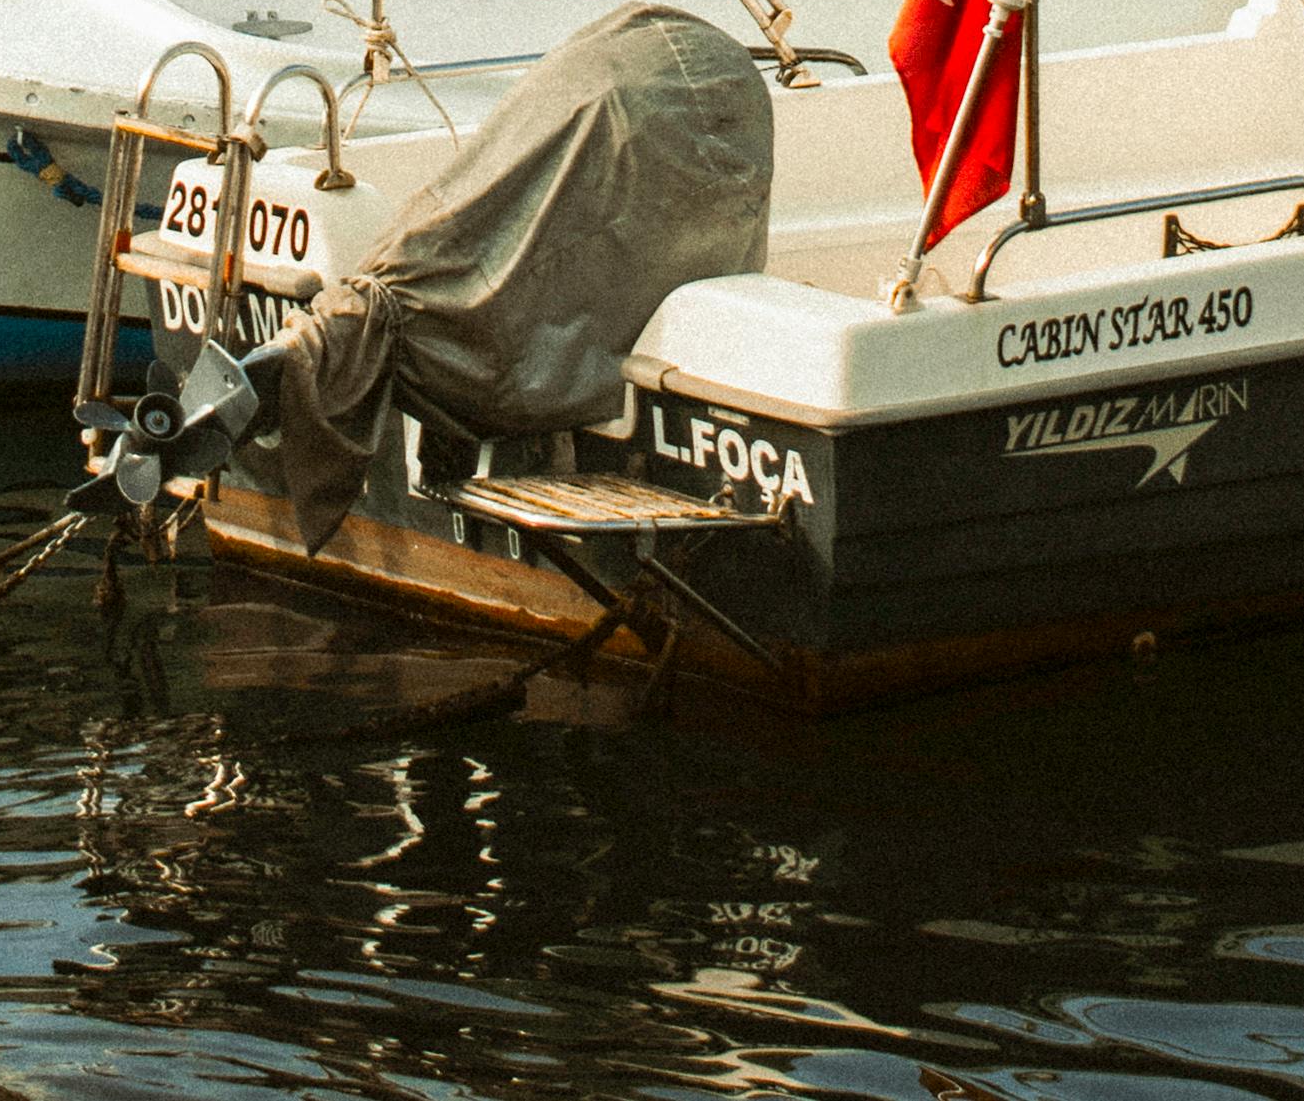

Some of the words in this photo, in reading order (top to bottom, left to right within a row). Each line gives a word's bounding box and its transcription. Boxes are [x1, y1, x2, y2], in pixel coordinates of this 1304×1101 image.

[249, 199, 309, 262] 070
[997, 309, 1105, 368] CABIN
[1108, 295, 1193, 350] STAR
[1198, 286, 1253, 334] 450
[1005, 397, 1139, 450] YILDIZ
